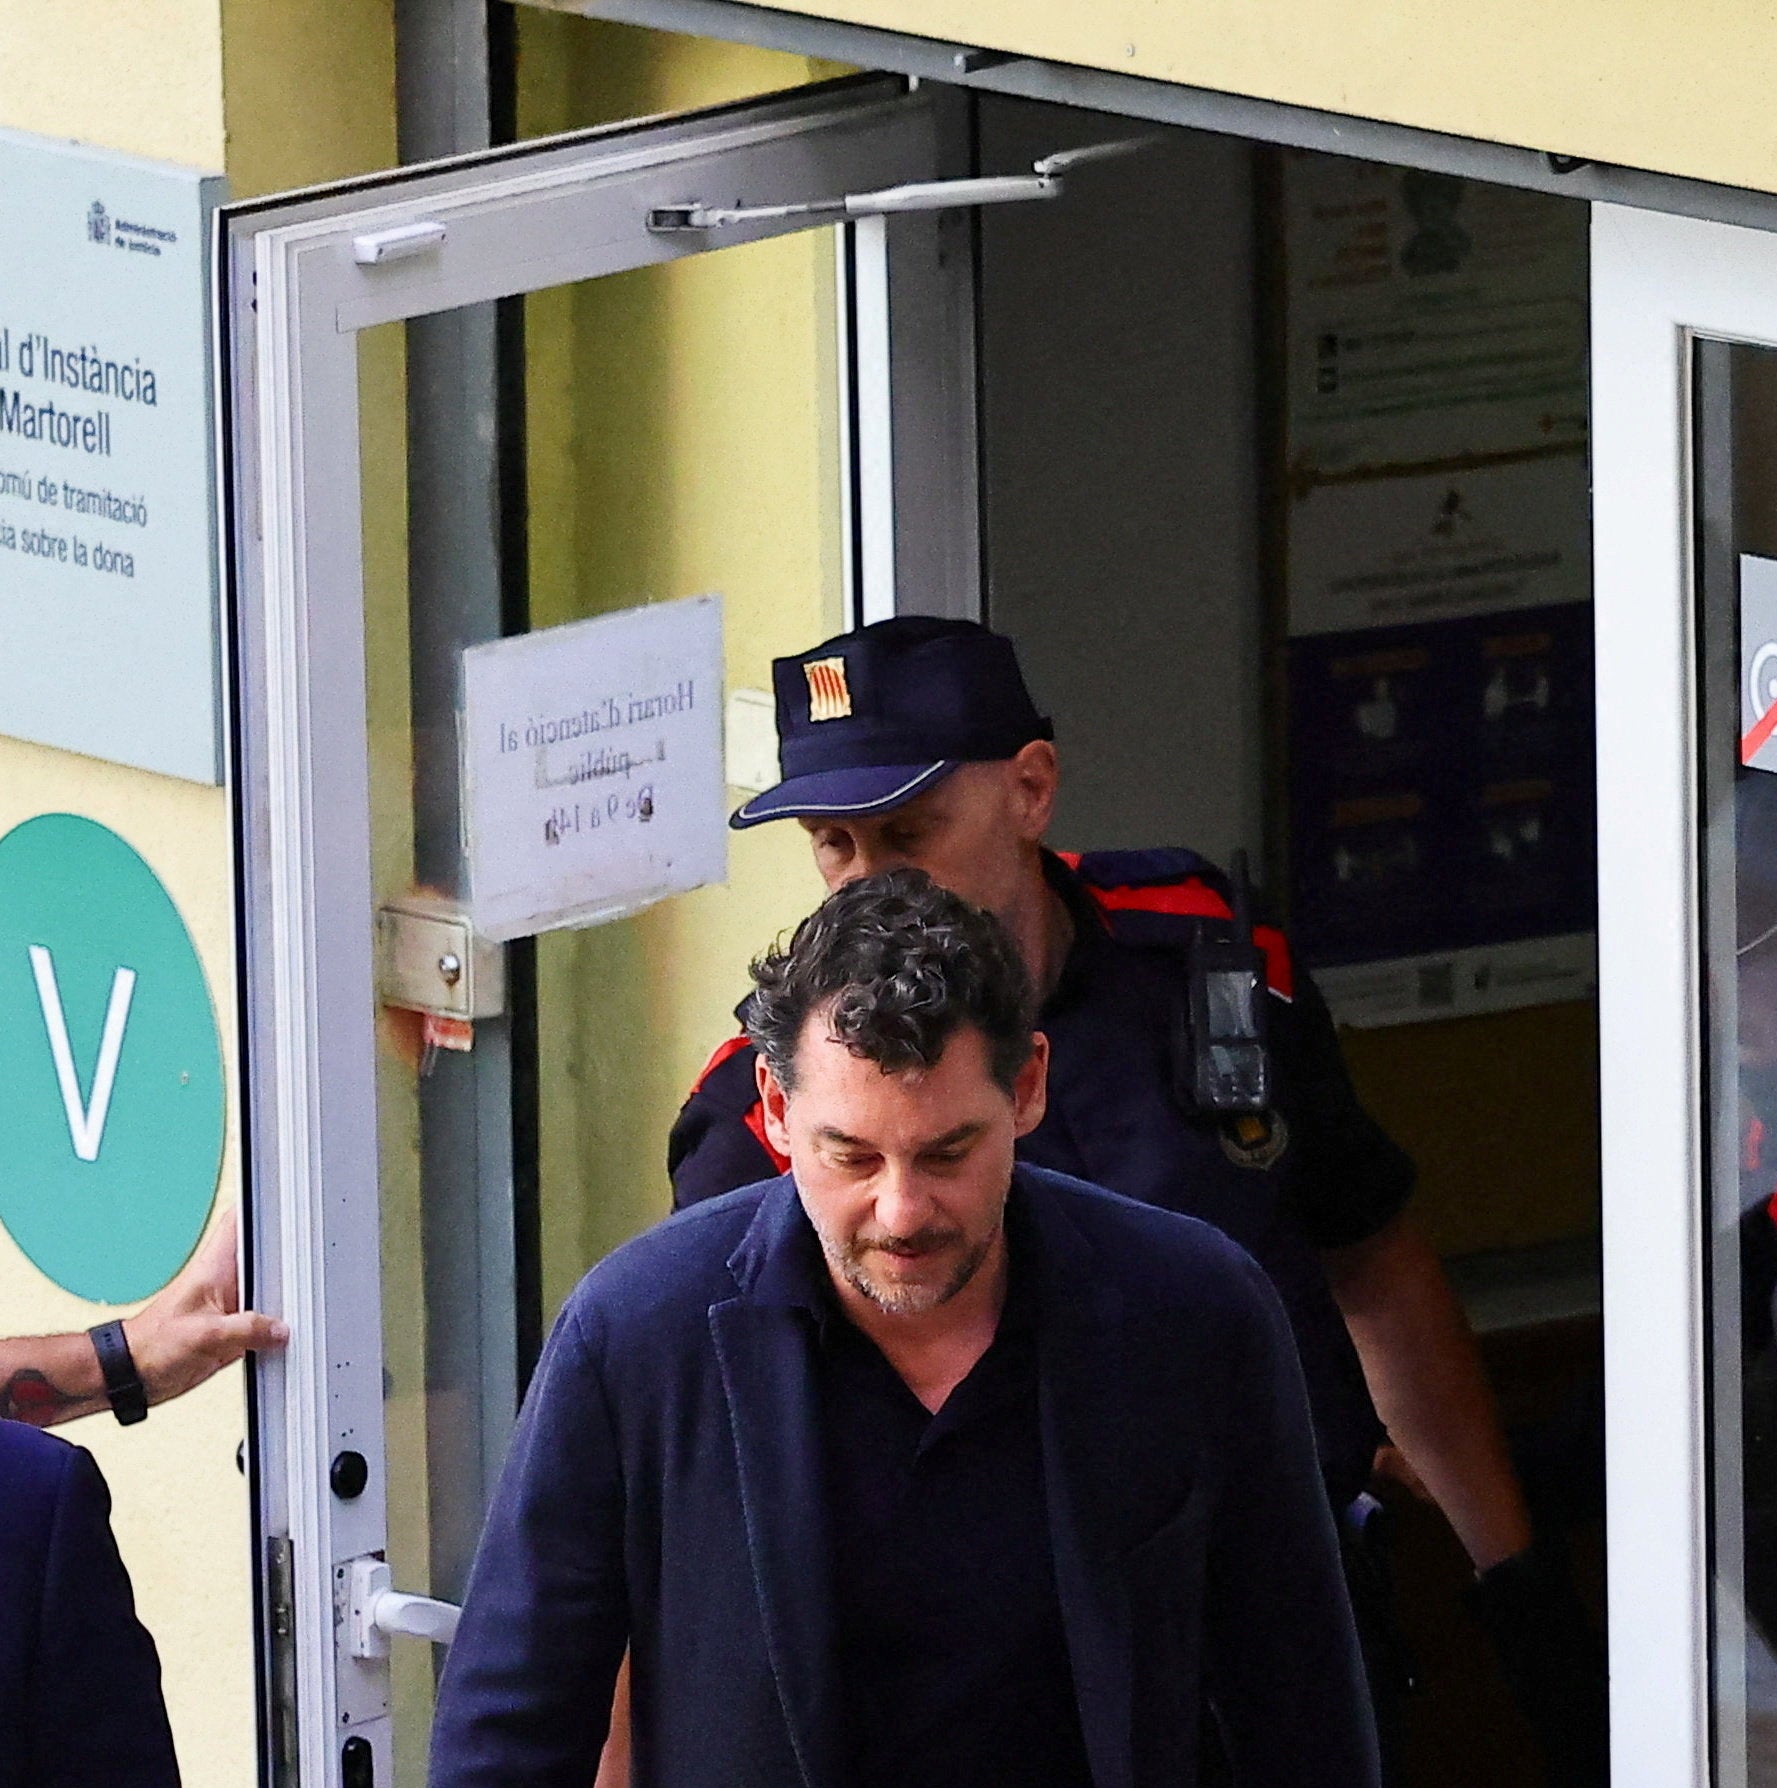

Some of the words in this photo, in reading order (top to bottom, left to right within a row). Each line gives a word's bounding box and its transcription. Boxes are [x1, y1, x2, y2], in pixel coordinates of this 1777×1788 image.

[19, 333, 157, 407] d'Instància
[37, 476, 57, 505] de
[63, 480, 148, 527] tramitació
[21, 528, 68, 562] sobre
[73, 535, 88, 566] la
[93, 541, 134, 578] dona
[27, 941, 138, 1162] V
